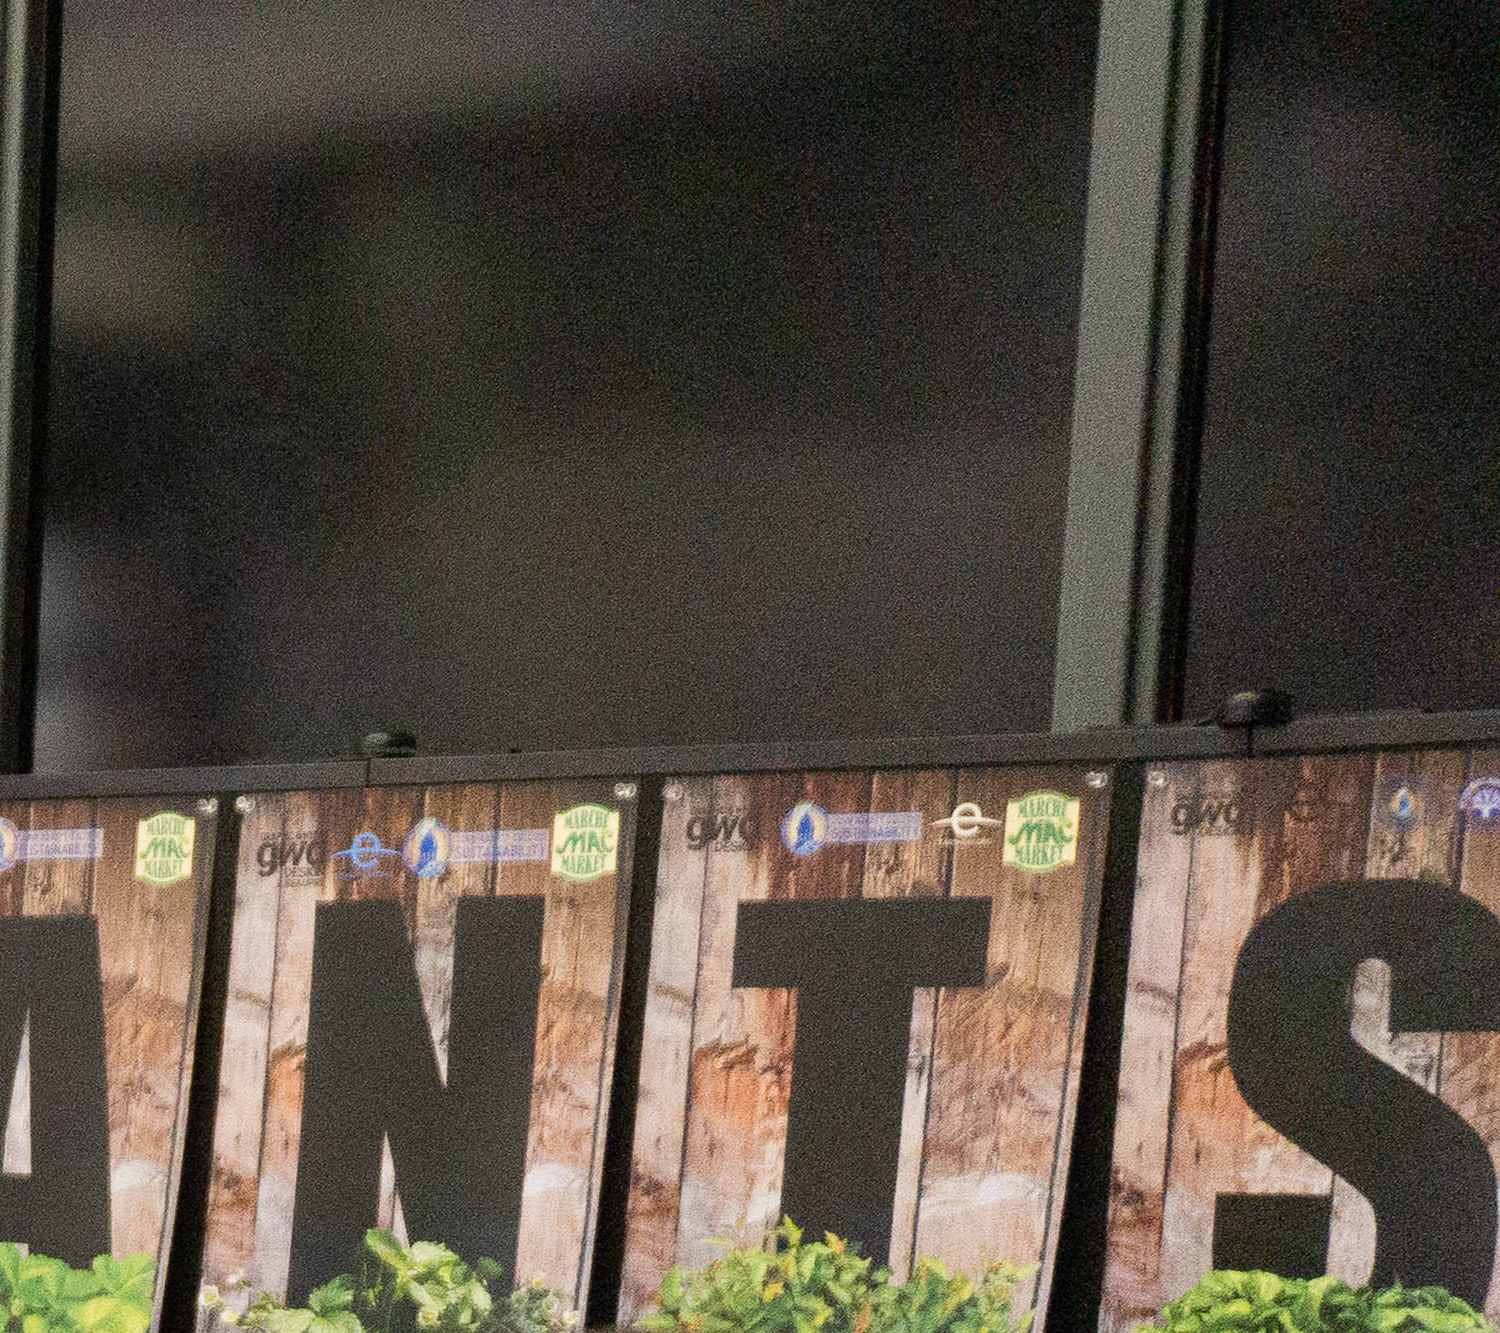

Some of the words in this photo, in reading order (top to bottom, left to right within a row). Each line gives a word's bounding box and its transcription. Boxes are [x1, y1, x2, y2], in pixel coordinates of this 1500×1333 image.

[555, 829, 614, 855] MAC
[1006, 819, 1073, 846] MAC
[139, 836, 191, 859] MAC
